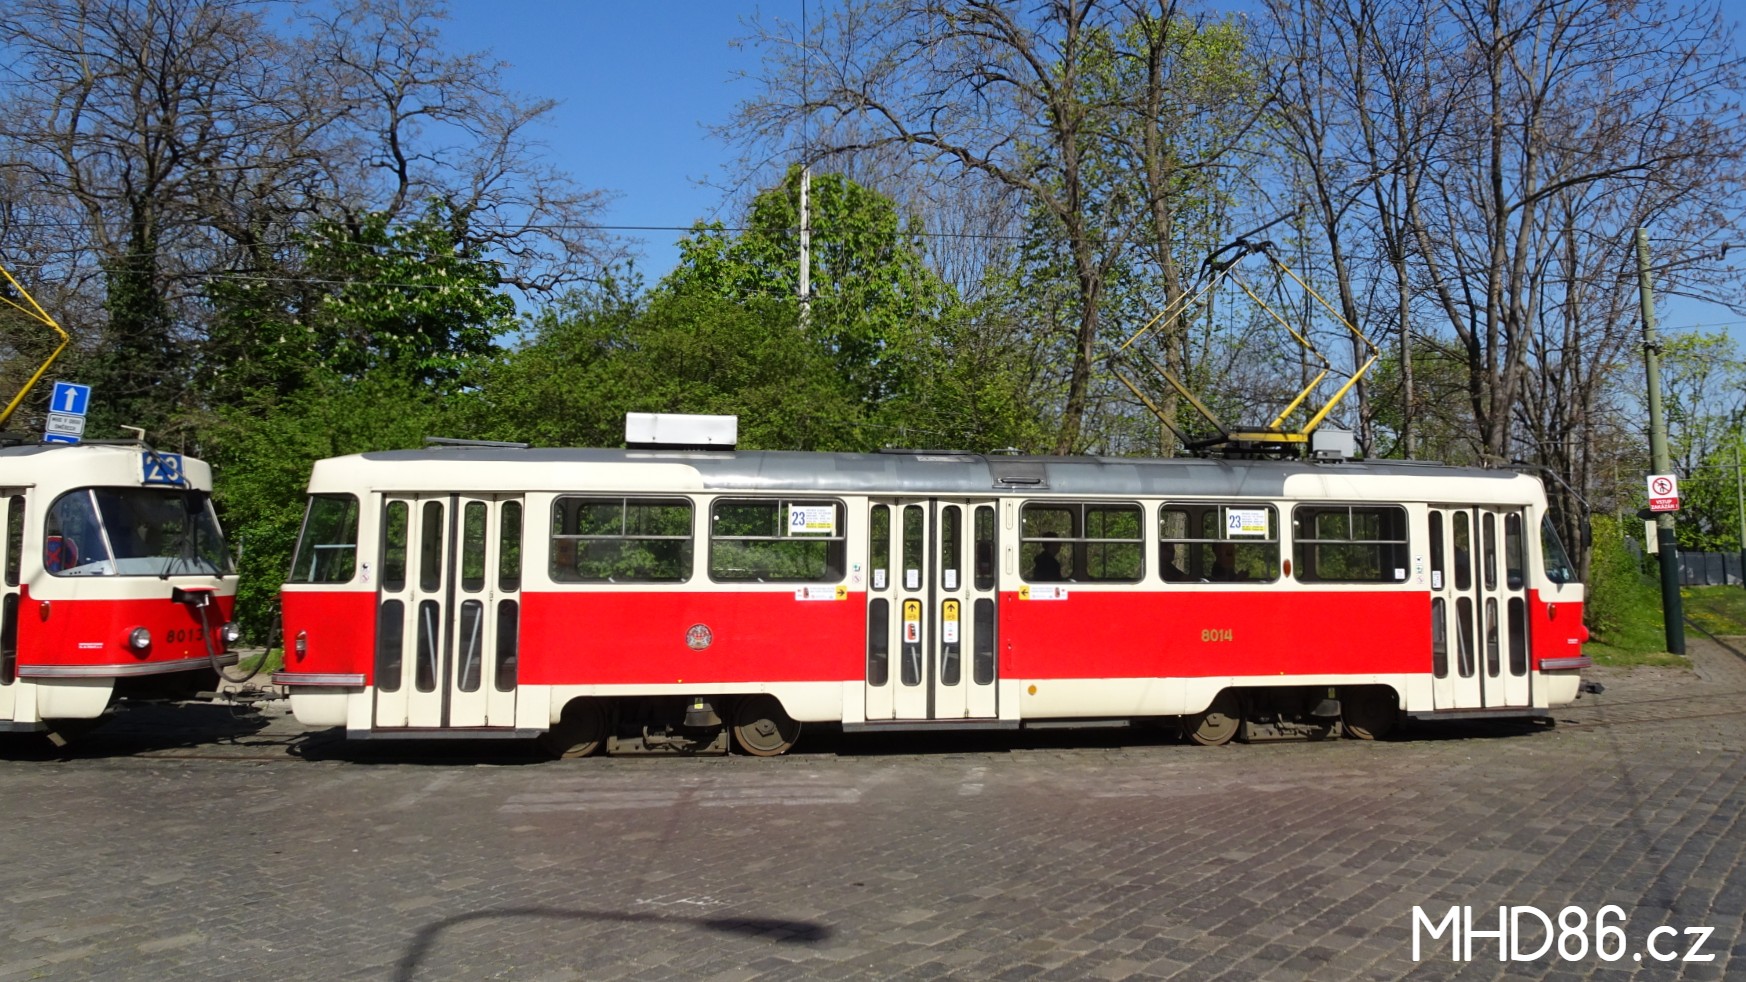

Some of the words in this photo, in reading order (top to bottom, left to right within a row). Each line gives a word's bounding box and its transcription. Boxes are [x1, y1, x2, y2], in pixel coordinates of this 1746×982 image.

[146, 456, 179, 481] 23
[791, 511, 806, 526] 23
[1229, 515, 1241, 528] 23
[166, 629, 204, 643] 8013
[1201, 628, 1233, 642] 8014
